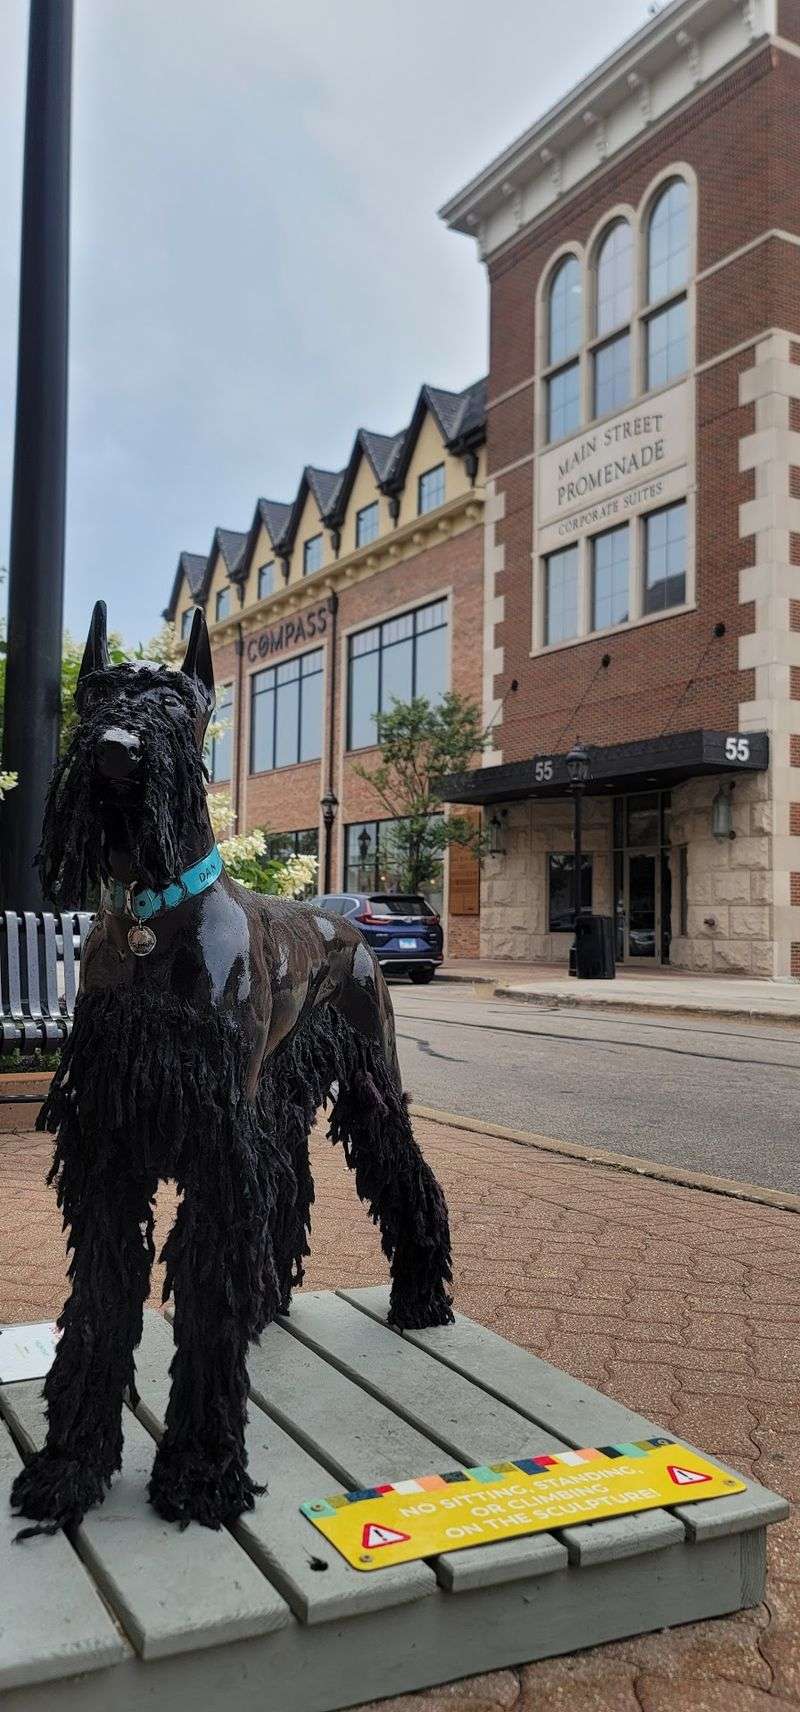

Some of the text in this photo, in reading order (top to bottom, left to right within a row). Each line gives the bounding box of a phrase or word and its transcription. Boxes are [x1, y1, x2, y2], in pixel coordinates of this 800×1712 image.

[557, 439, 665, 506] PROMENADE
[558, 414, 664, 481] MAIN STREET
[558, 482, 663, 536] CORPORATE SUITES
[247, 607, 327, 663] COMPASS
[535, 760, 553, 782] 55
[725, 737, 750, 762] 55
[399, 1503, 437, 1518] NO
[445, 1487, 662, 1538] ON THE SCULPTURE!
[470, 1484, 609, 1517] OR CLIMBING
